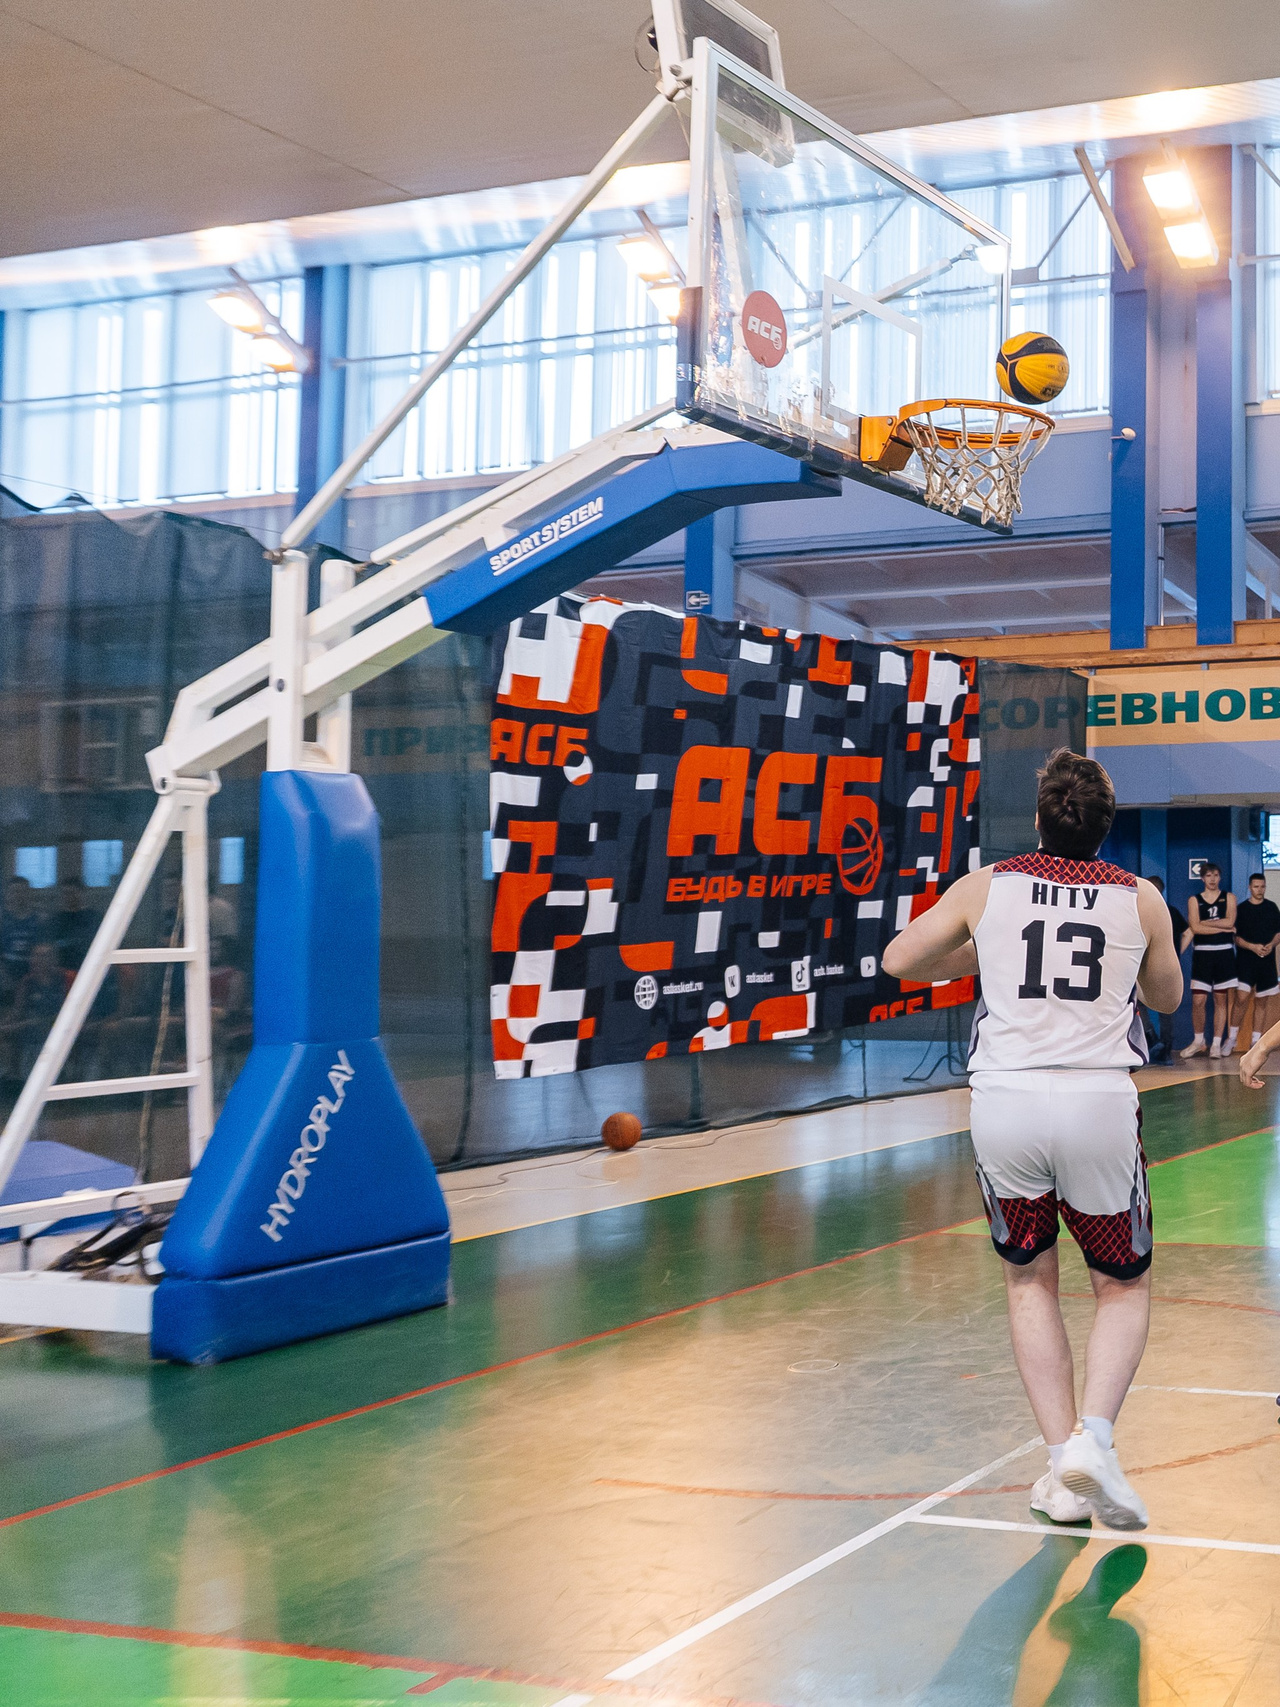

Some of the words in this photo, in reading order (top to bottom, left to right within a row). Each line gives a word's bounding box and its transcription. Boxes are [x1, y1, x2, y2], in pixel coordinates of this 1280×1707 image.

[747, 315, 783, 351] АСБ
[666, 744, 884, 895] АСБ
[666, 875, 743, 904] БУДЬ
[746, 874, 767, 898] В
[770, 872, 833, 898] ИГРЕ
[1031, 881, 1099, 911] НГТУ
[1017, 919, 1106, 1003] 13
[259, 1049, 356, 1243] HYDROPLAY
